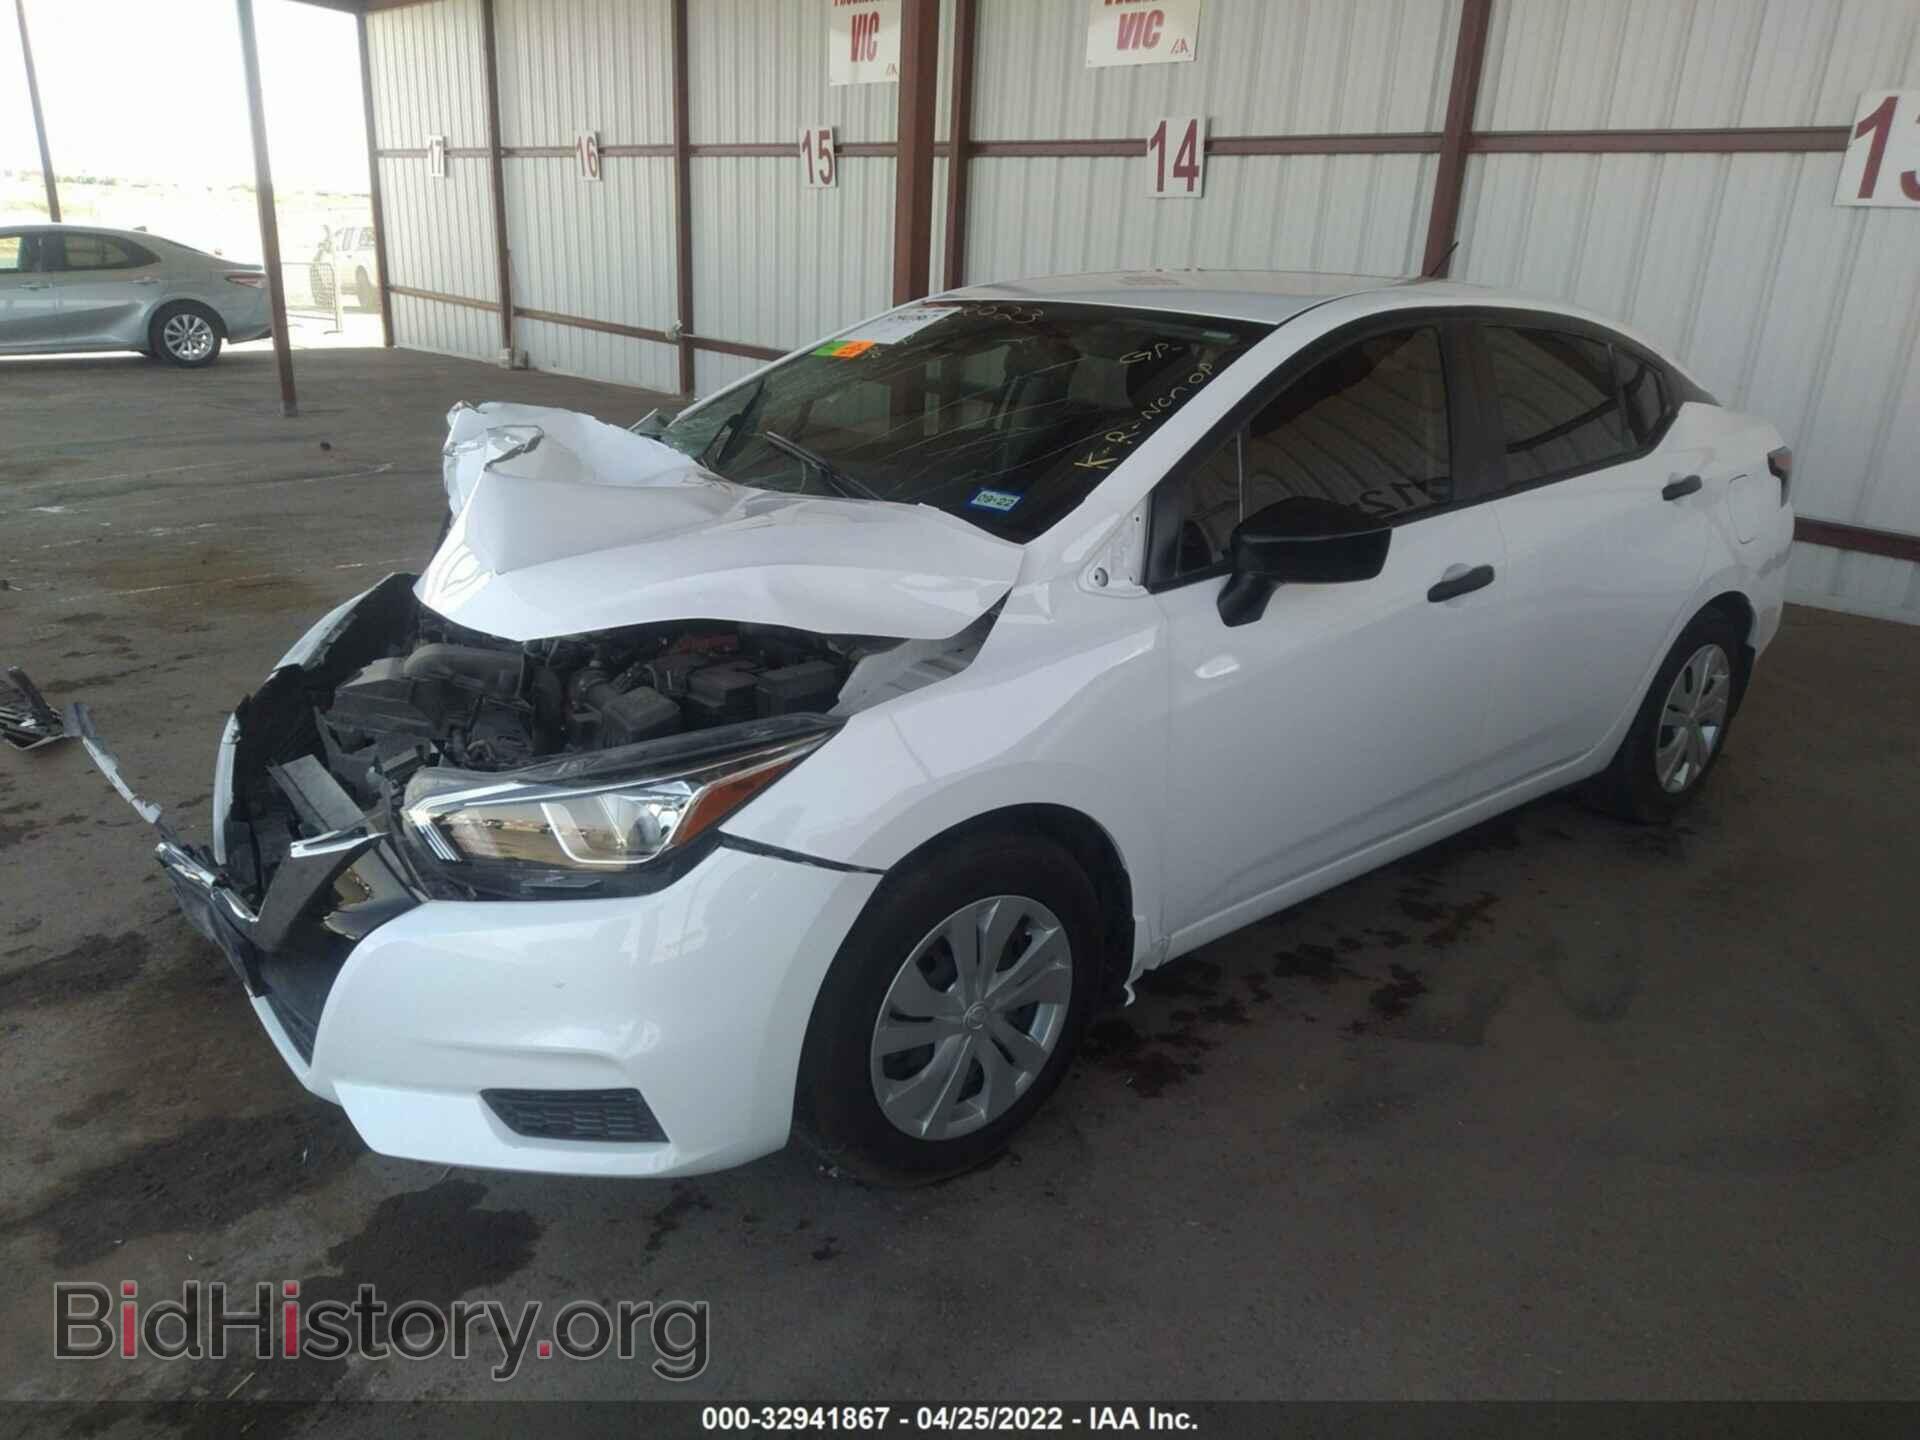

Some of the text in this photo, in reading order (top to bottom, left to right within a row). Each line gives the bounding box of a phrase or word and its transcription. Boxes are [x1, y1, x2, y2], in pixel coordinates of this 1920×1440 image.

[851, 11, 880, 62] VIC
[1116, 9, 1165, 50] VIC
[428, 139, 443, 174] 17
[576, 135, 599, 178] 16
[802, 129, 833, 185] 15
[1149, 118, 1200, 193] 14
